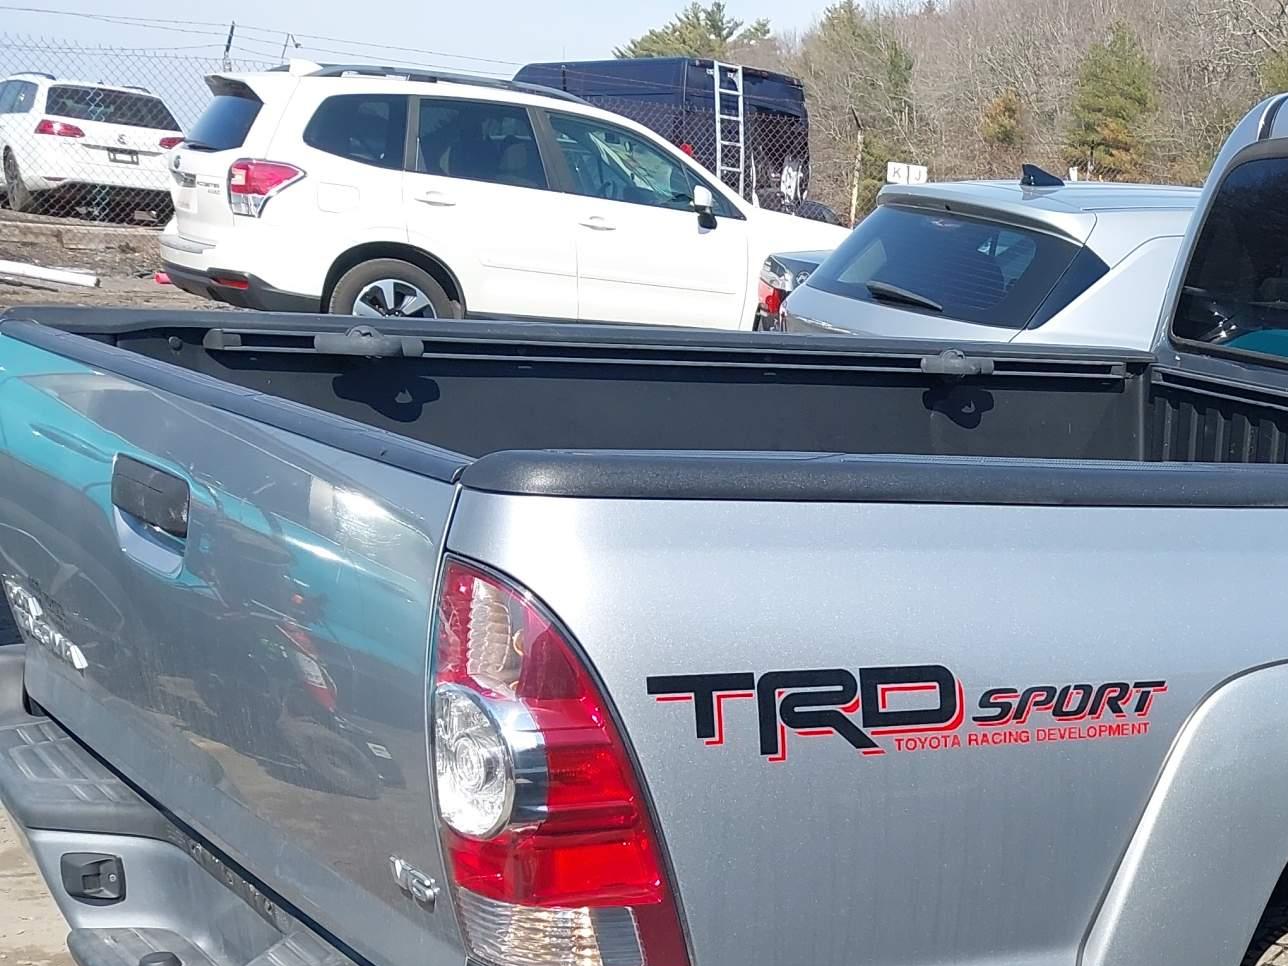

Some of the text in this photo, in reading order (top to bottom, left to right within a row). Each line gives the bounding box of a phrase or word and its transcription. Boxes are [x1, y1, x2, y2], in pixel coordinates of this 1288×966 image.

[892, 167, 902, 179] K
[914, 168, 922, 182] J
[646, 664, 1168, 762] TRD SPORT
[894, 721, 1150, 752] TOYOTA RACING DEVELOPMENT
[389, 856, 440, 900] V6
